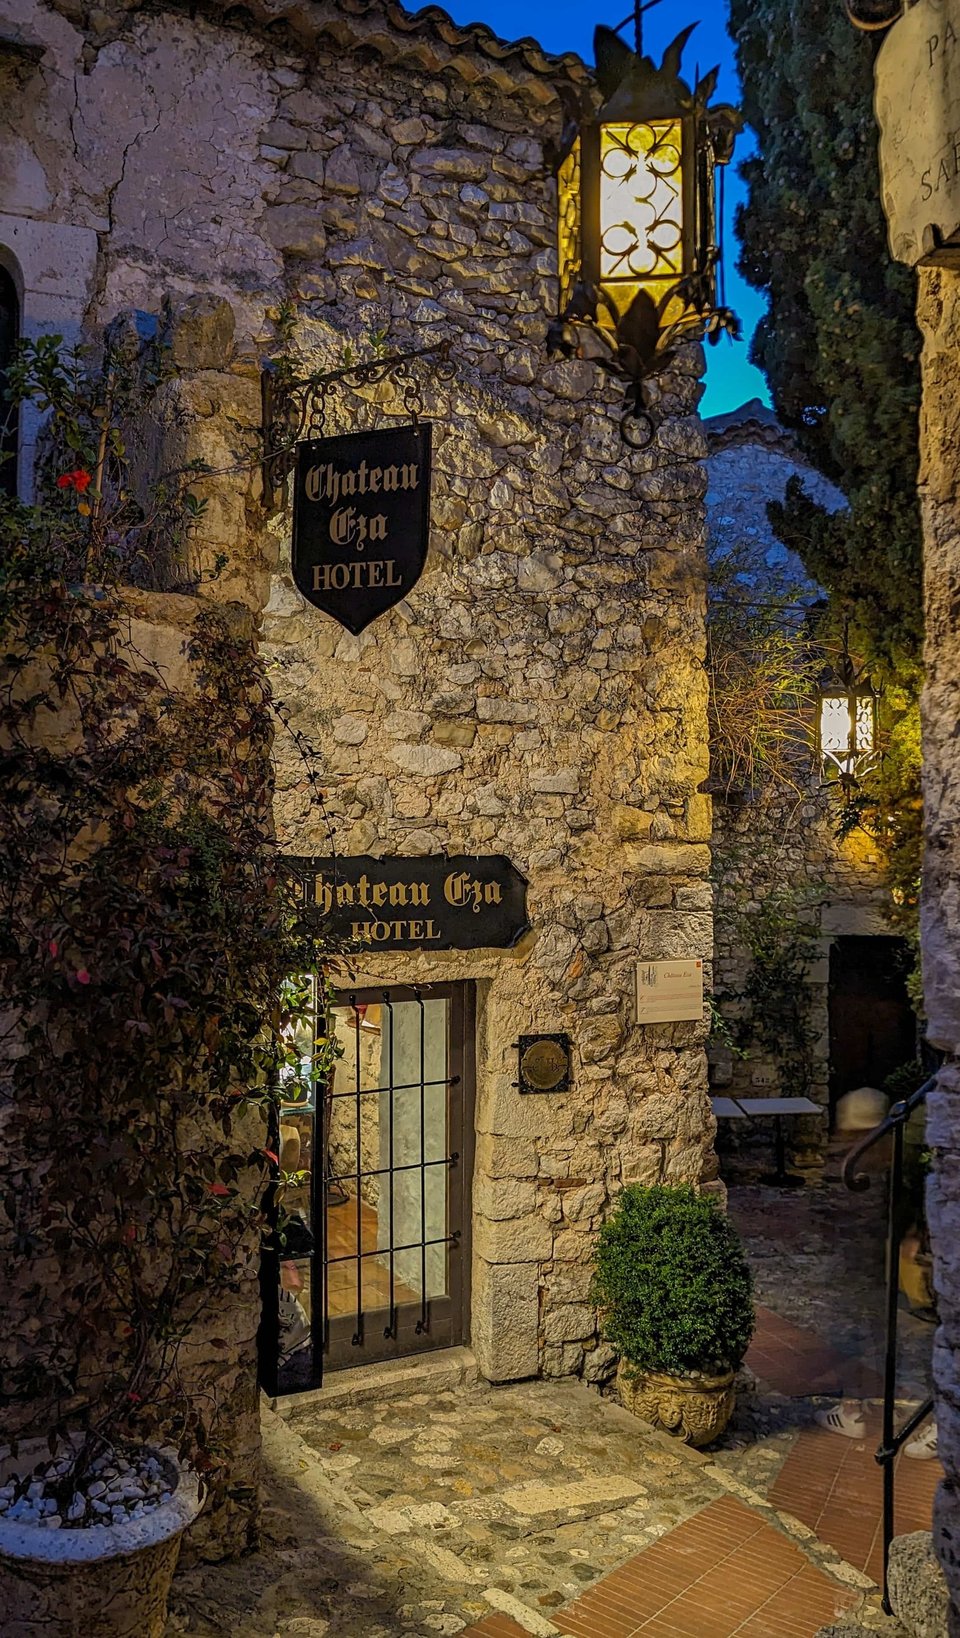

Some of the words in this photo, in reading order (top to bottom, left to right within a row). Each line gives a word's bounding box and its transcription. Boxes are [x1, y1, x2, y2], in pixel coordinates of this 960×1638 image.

[305, 460, 419, 507] Chateau
[329, 506, 389, 551] Eza
[312, 560, 402, 591] HOTEL
[444, 871, 503, 913] Eza
[350, 919, 441, 941] HOTEL
